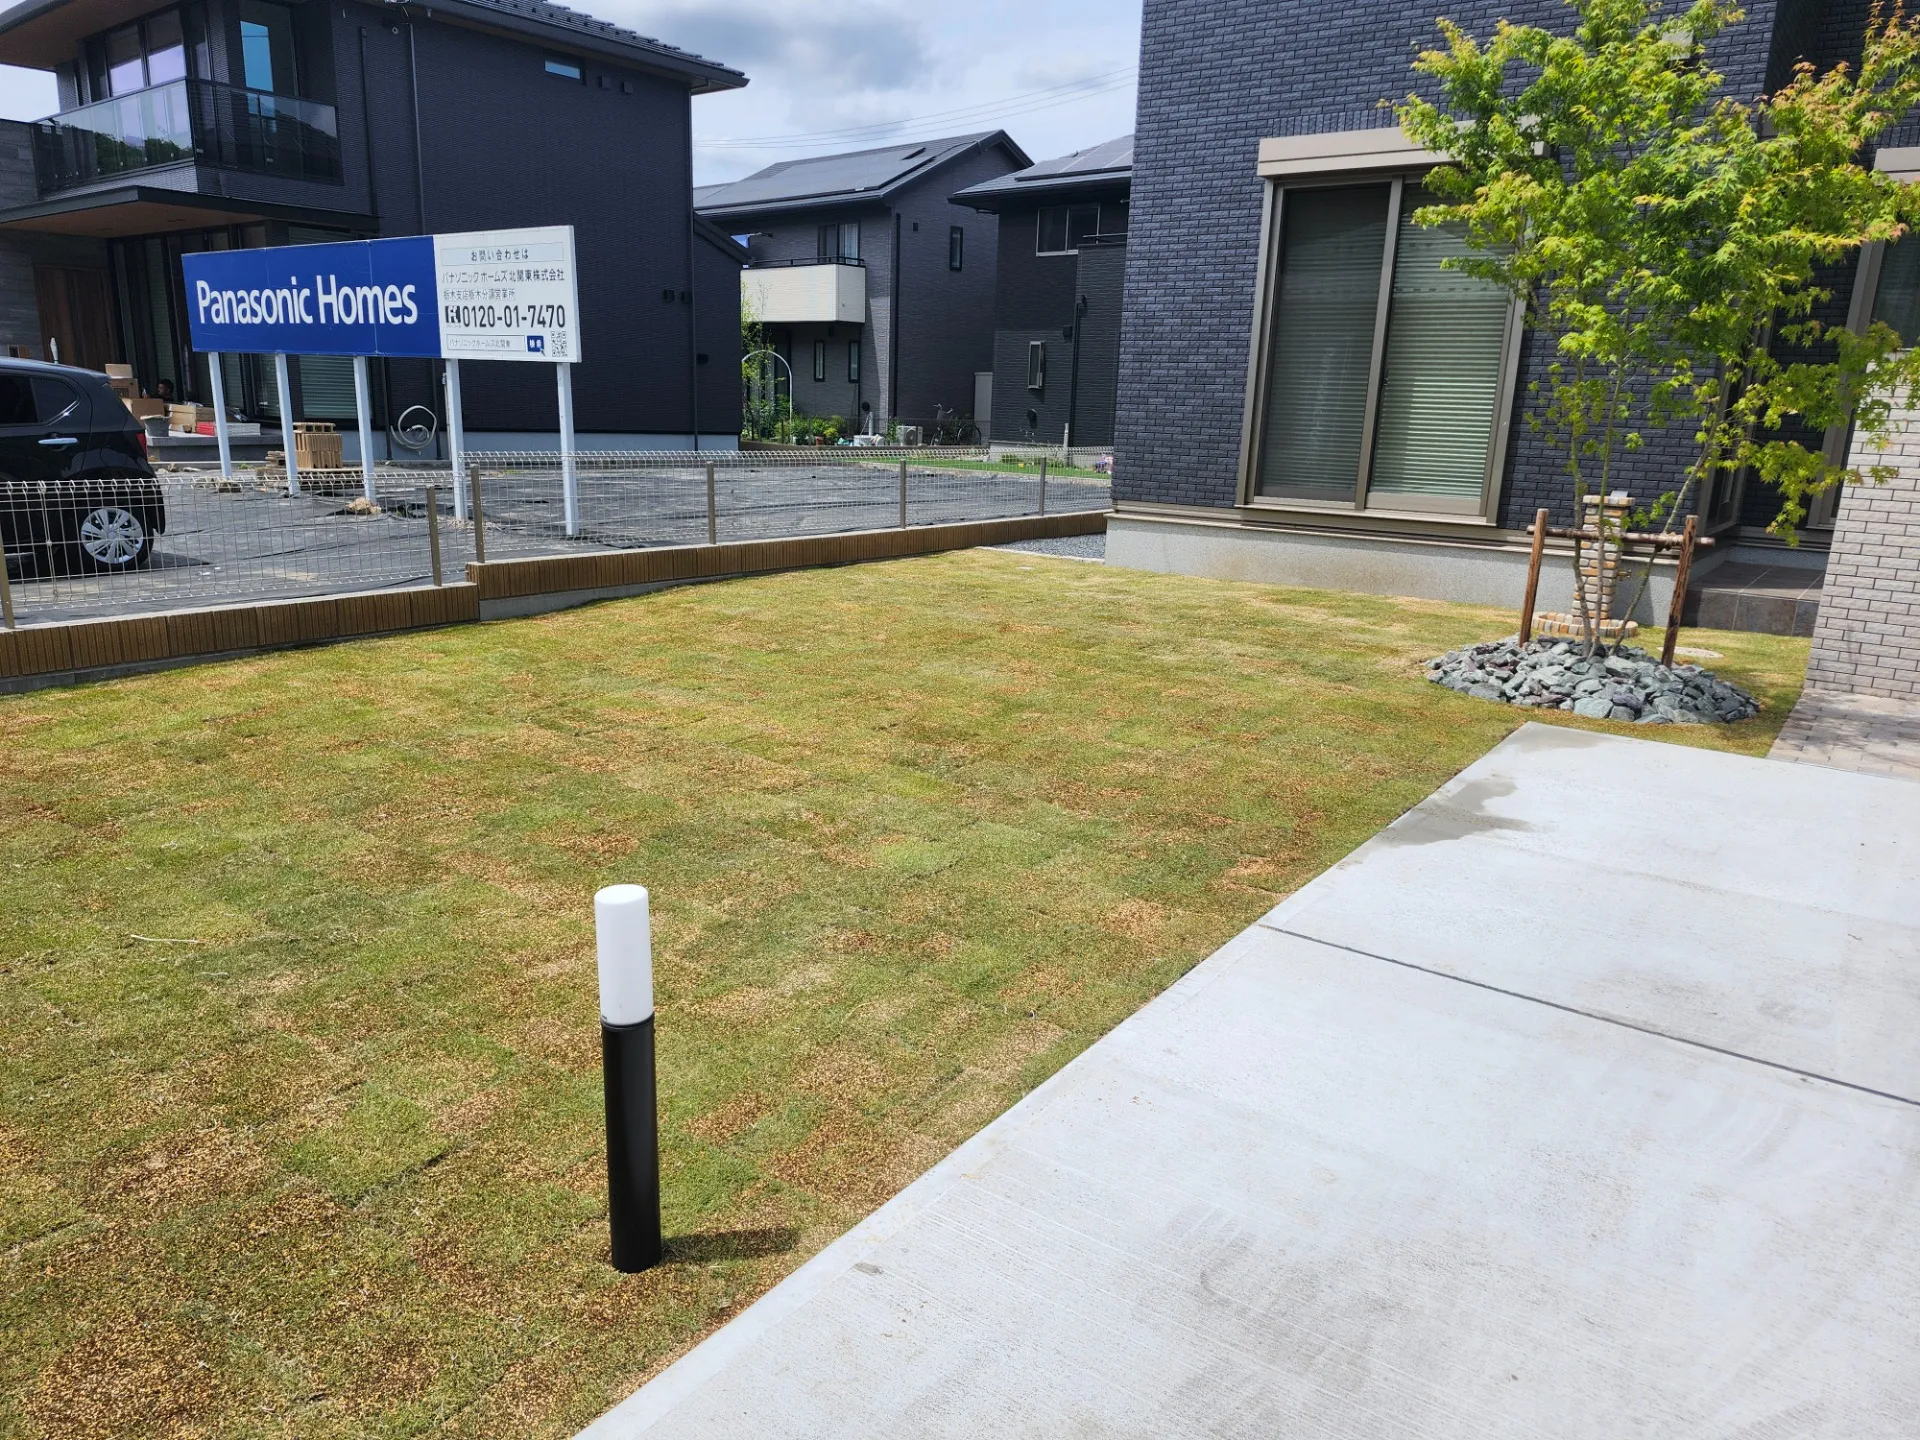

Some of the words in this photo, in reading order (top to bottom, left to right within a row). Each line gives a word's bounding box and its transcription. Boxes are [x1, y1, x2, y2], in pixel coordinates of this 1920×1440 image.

[471, 249, 529, 262] お問い合わせは
[196, 276, 314, 325] Panasonic
[316, 274, 418, 325] Homes
[462, 304, 566, 328] 0120-01-7470
